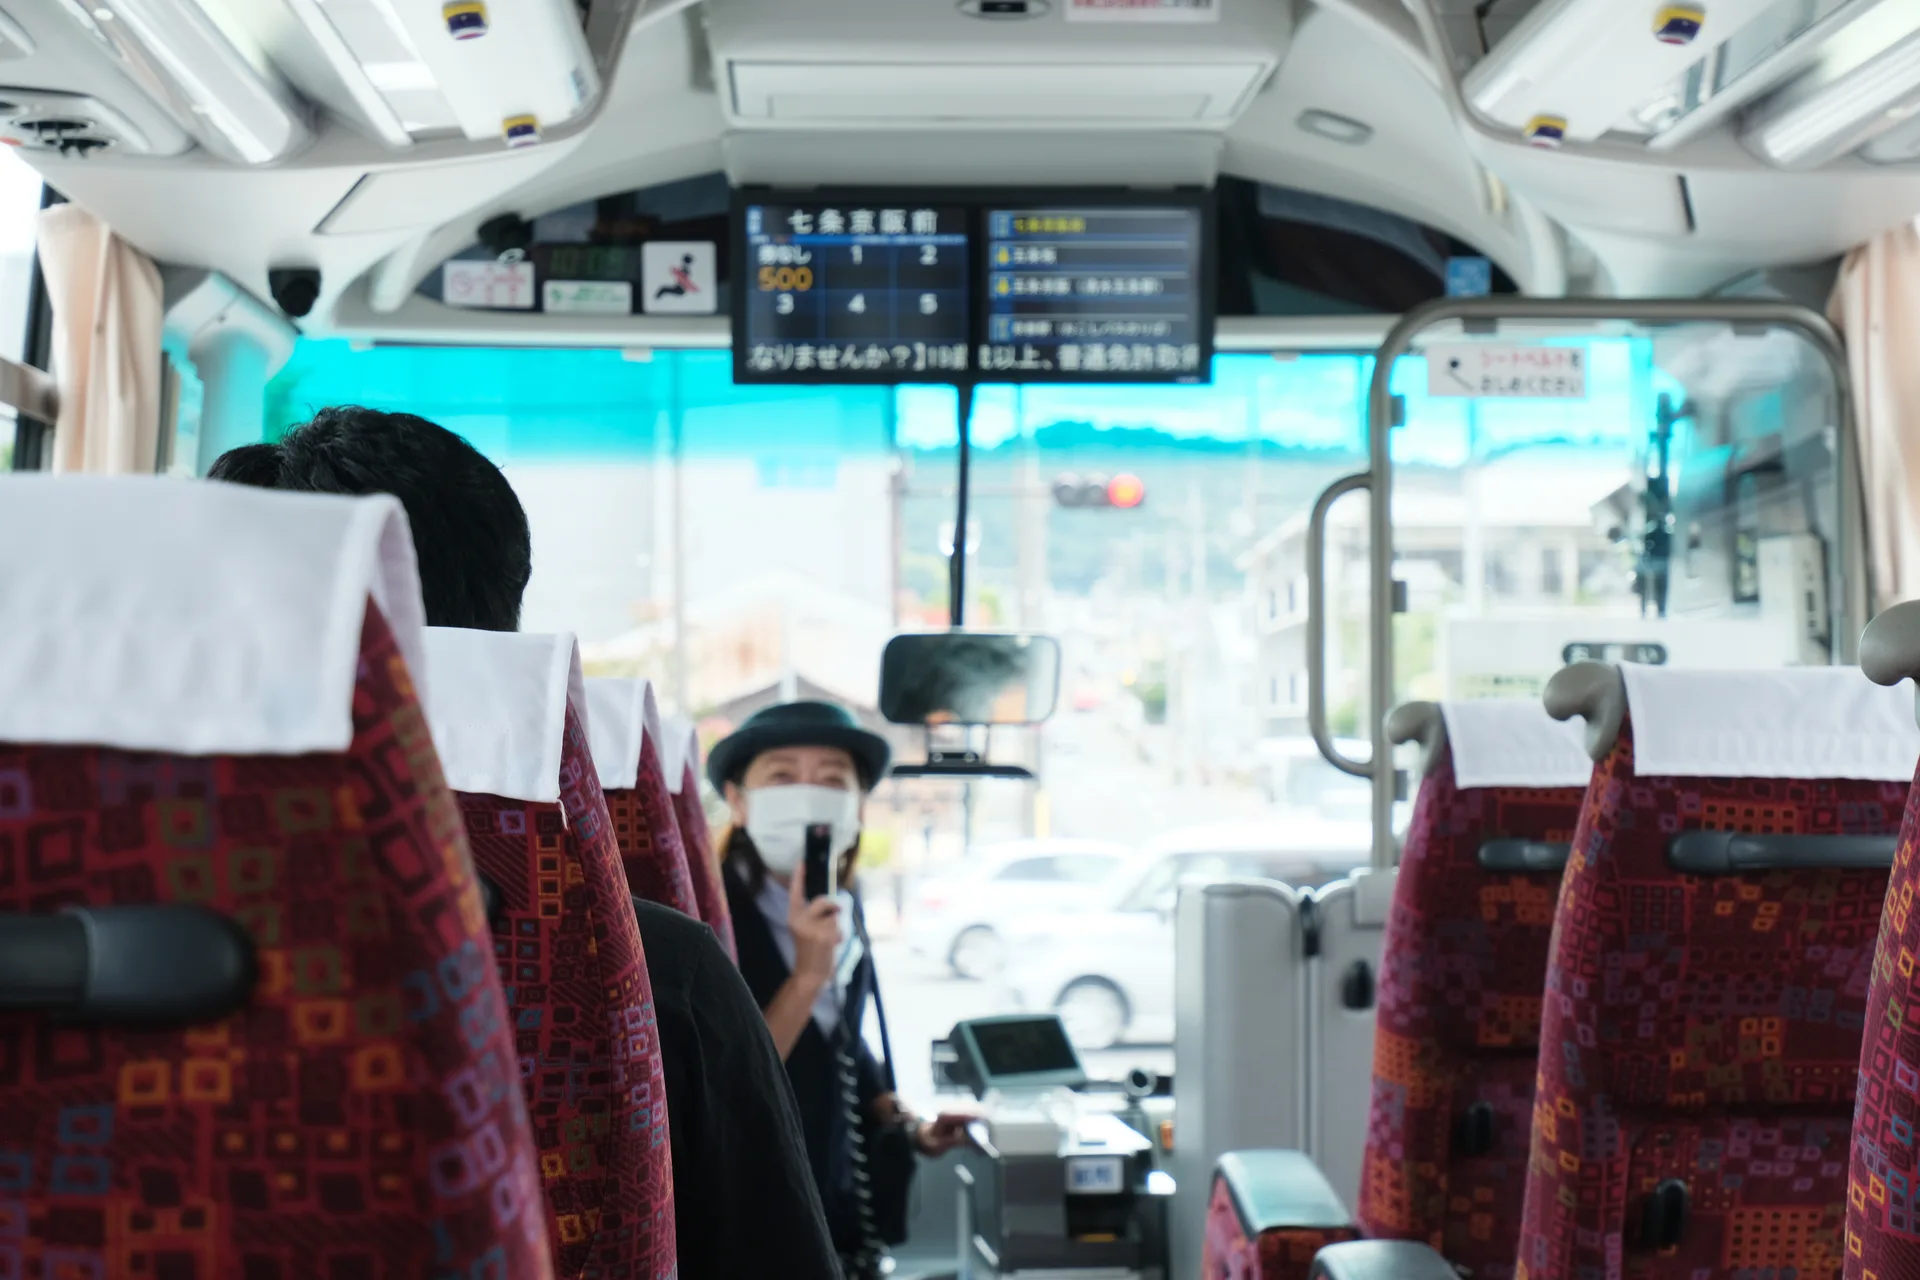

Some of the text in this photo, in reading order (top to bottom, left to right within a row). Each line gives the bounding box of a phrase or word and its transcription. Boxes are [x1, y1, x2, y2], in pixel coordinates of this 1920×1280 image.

[788, 209, 938, 235] 七条京阪前
[851, 245, 863, 265] 1
[920, 245, 938, 265] 2
[758, 266, 813, 292] 500
[776, 293, 794, 315] 3
[848, 293, 866, 314] 4
[920, 293, 938, 315] 5
